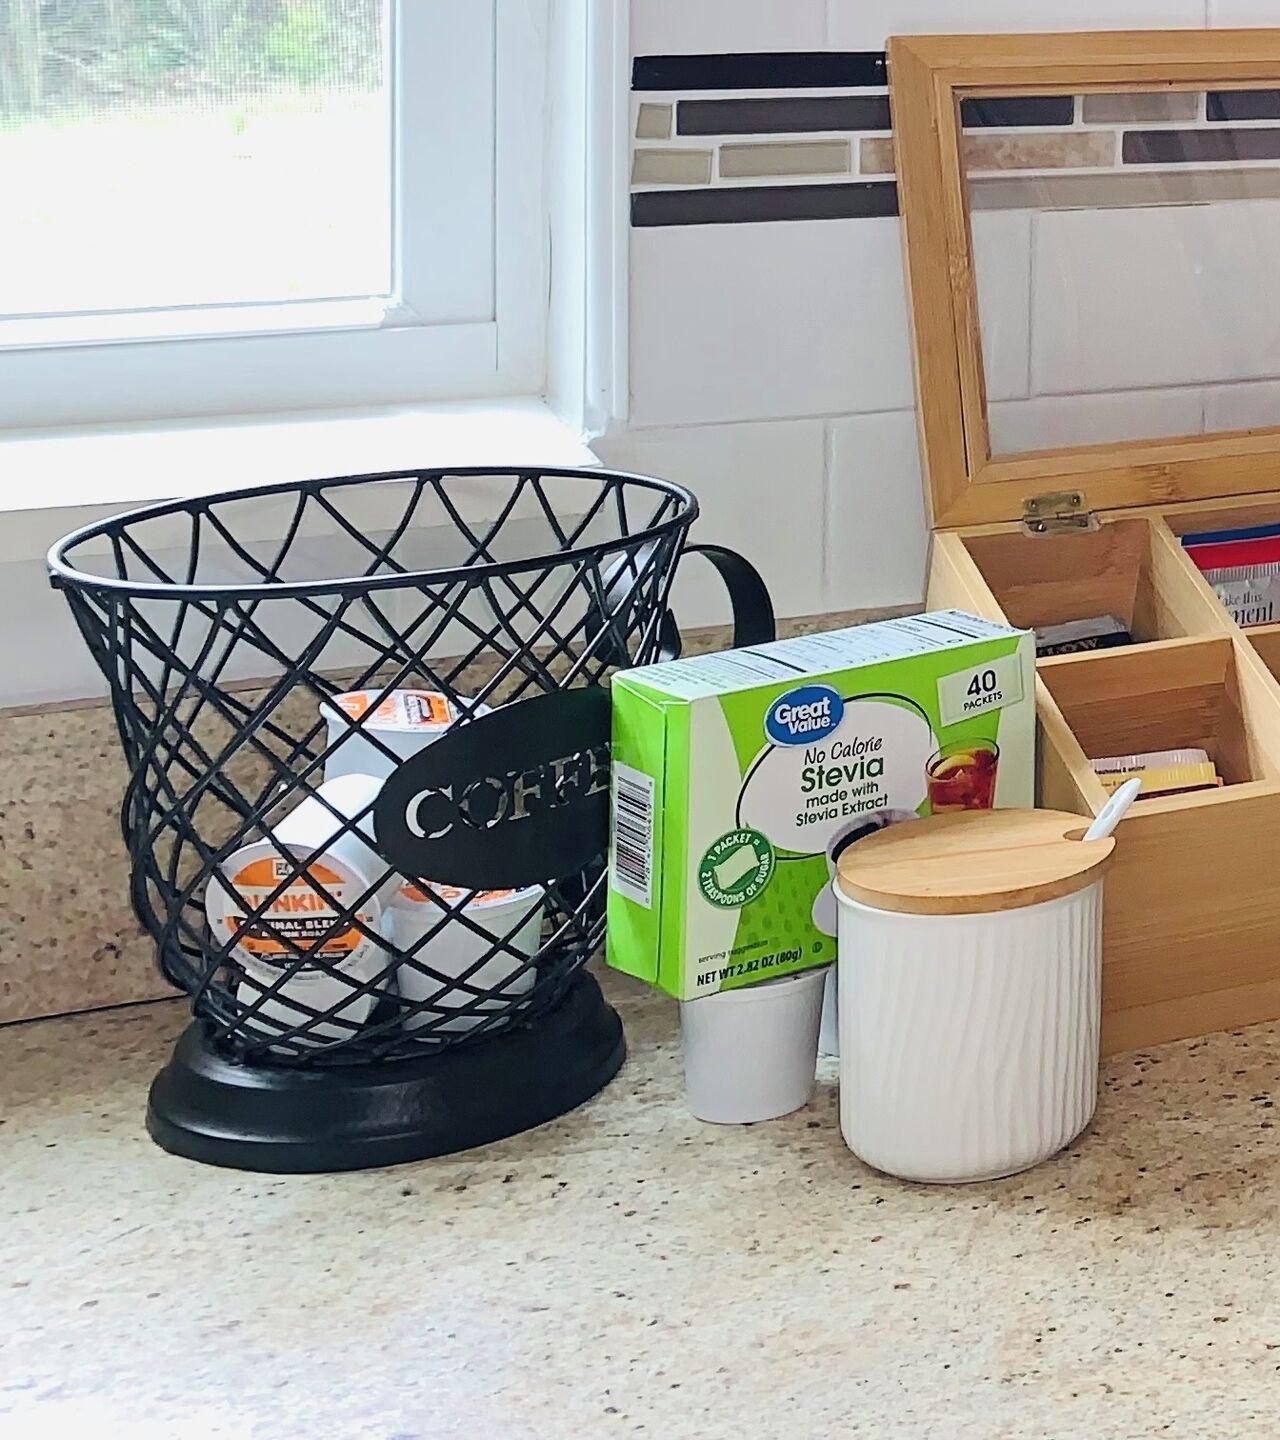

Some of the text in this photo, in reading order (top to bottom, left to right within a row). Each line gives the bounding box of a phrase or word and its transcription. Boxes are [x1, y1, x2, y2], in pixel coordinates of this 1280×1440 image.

[966, 669, 997, 696] 40
[774, 696, 832, 725] Great
[962, 689, 1003, 712] PACKETS
[787, 715, 831, 735] Value
[804, 736, 883, 766] No Calorie
[800, 755, 884, 793] Stevia
[806, 780, 879, 809] made with
[795, 793, 889, 827] Stevia Extract
[713, 832, 752, 856] PACKET
[701, 851, 770, 906] 2 TEASPOONS OF SUGAR
[696, 972, 717, 987] NET
[719, 966, 736, 980] WT
[736, 959, 760, 976] 2.82
[761, 954, 776, 967] OZ
